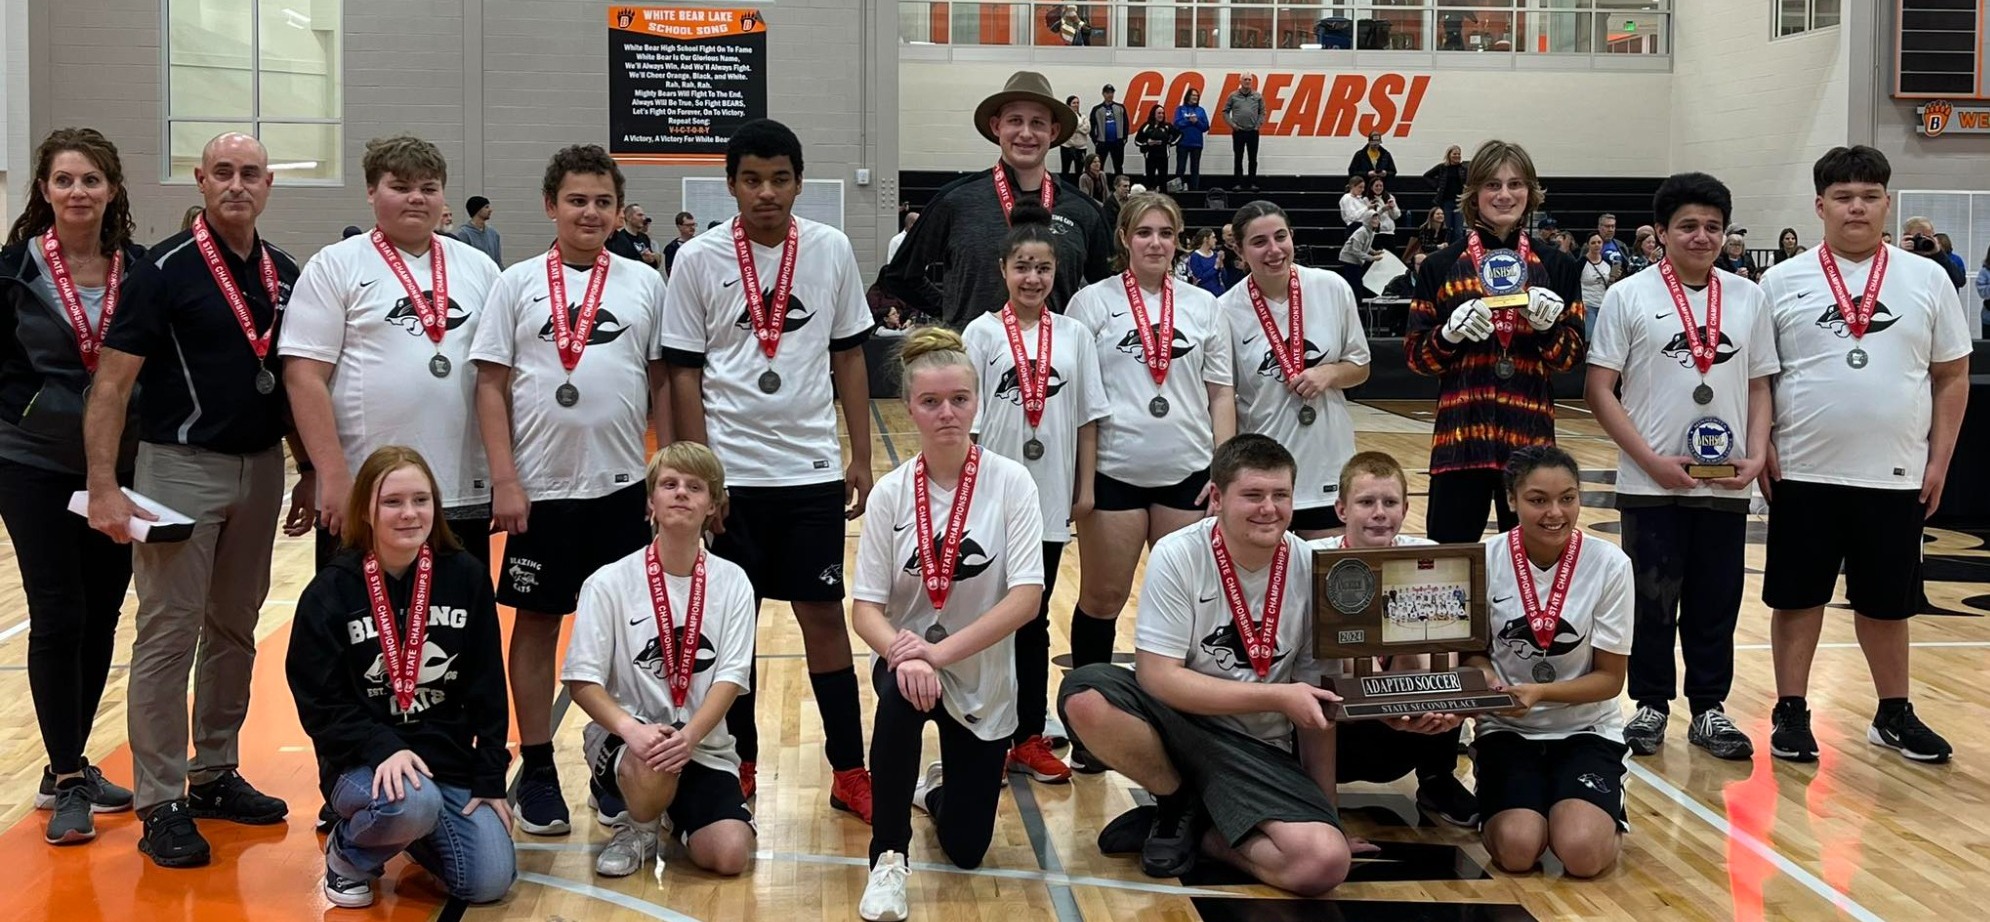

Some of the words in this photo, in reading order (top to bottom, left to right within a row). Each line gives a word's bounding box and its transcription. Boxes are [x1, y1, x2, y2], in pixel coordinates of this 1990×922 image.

[644, 10, 675, 20] WHITE
[679, 11, 704, 20] BEAR
[708, 11, 733, 21] LAKE
[648, 23, 693, 34] SCHOOL
[697, 24, 728, 34] SONG
[1124, 71, 1205, 134] GO
[1208, 73, 1431, 137] BEARS!
[1928, 116, 1941, 131] B
[49, 251, 64, 275] STATE
[379, 241, 394, 262] STATE
[738, 241, 750, 264] STATE
[1820, 248, 1831, 265] STATE
[202, 242, 219, 264] STATE
[214, 266, 250, 327] CHAMPIONSHIPS
[1667, 274, 1679, 293] STATE
[1129, 288, 1140, 305] STATE
[1862, 295, 1874, 312] STATE
[772, 304, 783, 327] STATE
[1256, 300, 1268, 321] STATE
[101, 317, 112, 340] STATE
[577, 320, 589, 340] STATE
[1008, 326, 1019, 343] STATE
[1160, 335, 1170, 356] STATE
[1036, 376, 1046, 398] STATE
[917, 477, 926, 501] STATE
[942, 548, 954, 574] STATE
[948, 477, 972, 545] CHAMPIONSHIPS
[918, 504, 935, 575] CHAMPIONSHIPS
[510, 557, 542, 570] BLAZING
[1549, 592, 1562, 616] STATE
[1556, 529, 1579, 590] CHAMPIONSHIPS
[513, 583, 531, 592] CATS
[652, 577, 664, 603] STATE
[1216, 549, 1230, 574] STATE
[1225, 577, 1254, 644] CHAMPIONSHIPS
[1262, 618, 1274, 643] STATE
[1268, 547, 1287, 613] CHAMPIONSHIPS
[1515, 553, 1537, 617] CHAMPIONSHIPS
[410, 573, 428, 646] CHAMPIONSHIPS
[686, 578, 703, 644] CHAMPIONSHIPS
[347, 606, 468, 644] BLNG
[377, 605, 400, 676] CHAMPIONSHIPS
[406, 650, 417, 676] STATE
[681, 648, 692, 673] STATE
[1366, 677, 1414, 694] ADAPTED
[1415, 674, 1460, 690] SOCCER
[1381, 704, 1409, 713] STATE
[1410, 701, 1447, 711] SECOND
[1448, 699, 1476, 708] PLACE
